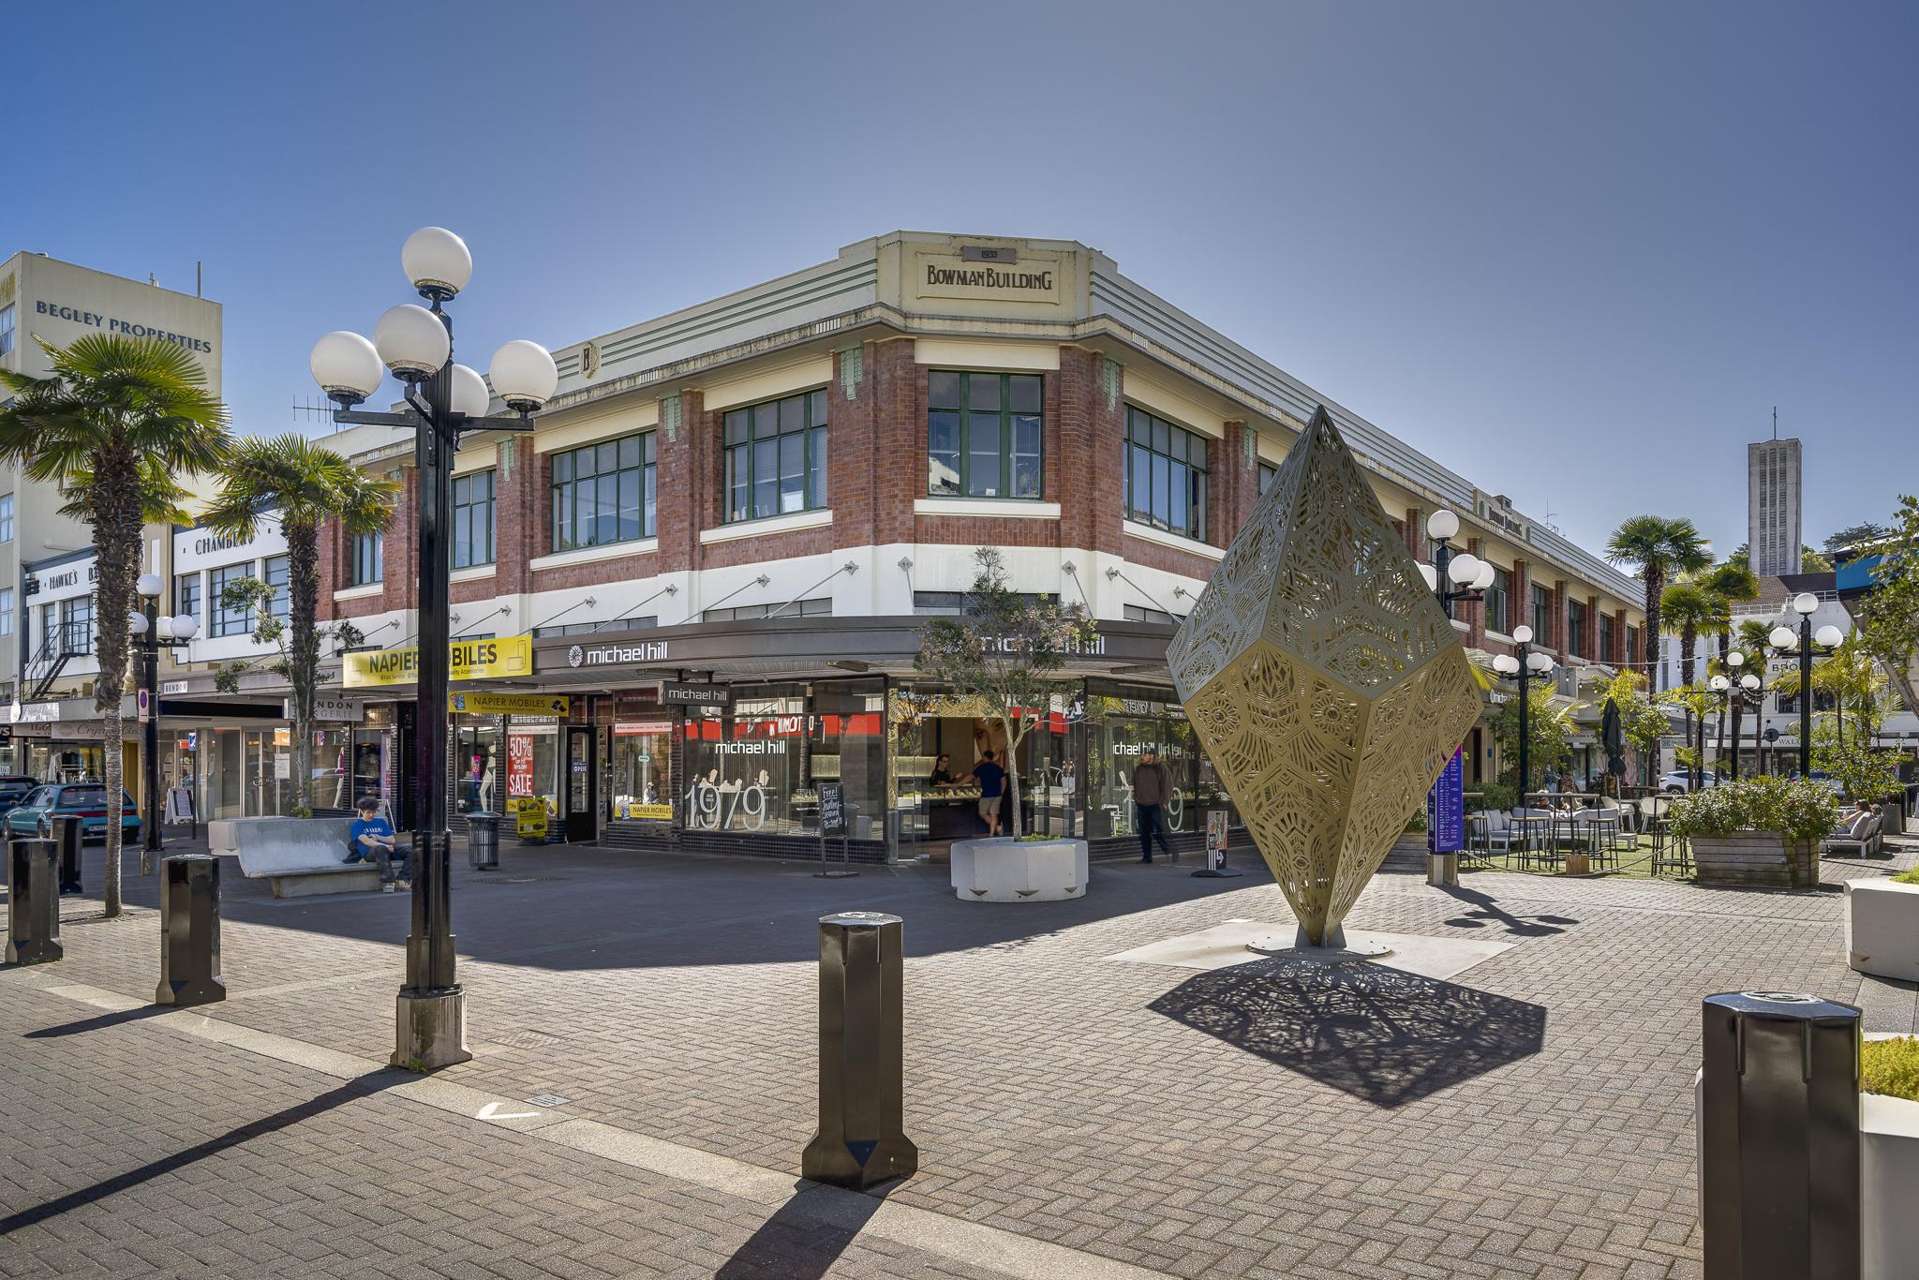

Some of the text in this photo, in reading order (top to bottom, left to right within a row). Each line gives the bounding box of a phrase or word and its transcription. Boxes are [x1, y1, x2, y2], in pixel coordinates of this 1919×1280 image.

[927, 265, 1053, 290] BOWMAN BUILDING
[36, 300, 212, 353] BEGLEY PROPERTIES
[448, 643, 498, 667] BILES
[587, 642, 668, 665] michael hill
[473, 697, 546, 708] NAPIER MOBILES
[668, 688, 727, 701] michael hill
[509, 737, 533, 757] 50%
[715, 740, 785, 754] michael hill
[1112, 741, 1141, 756] ichael
[509, 775, 533, 793] SALE
[685, 785, 766, 831] 1979
